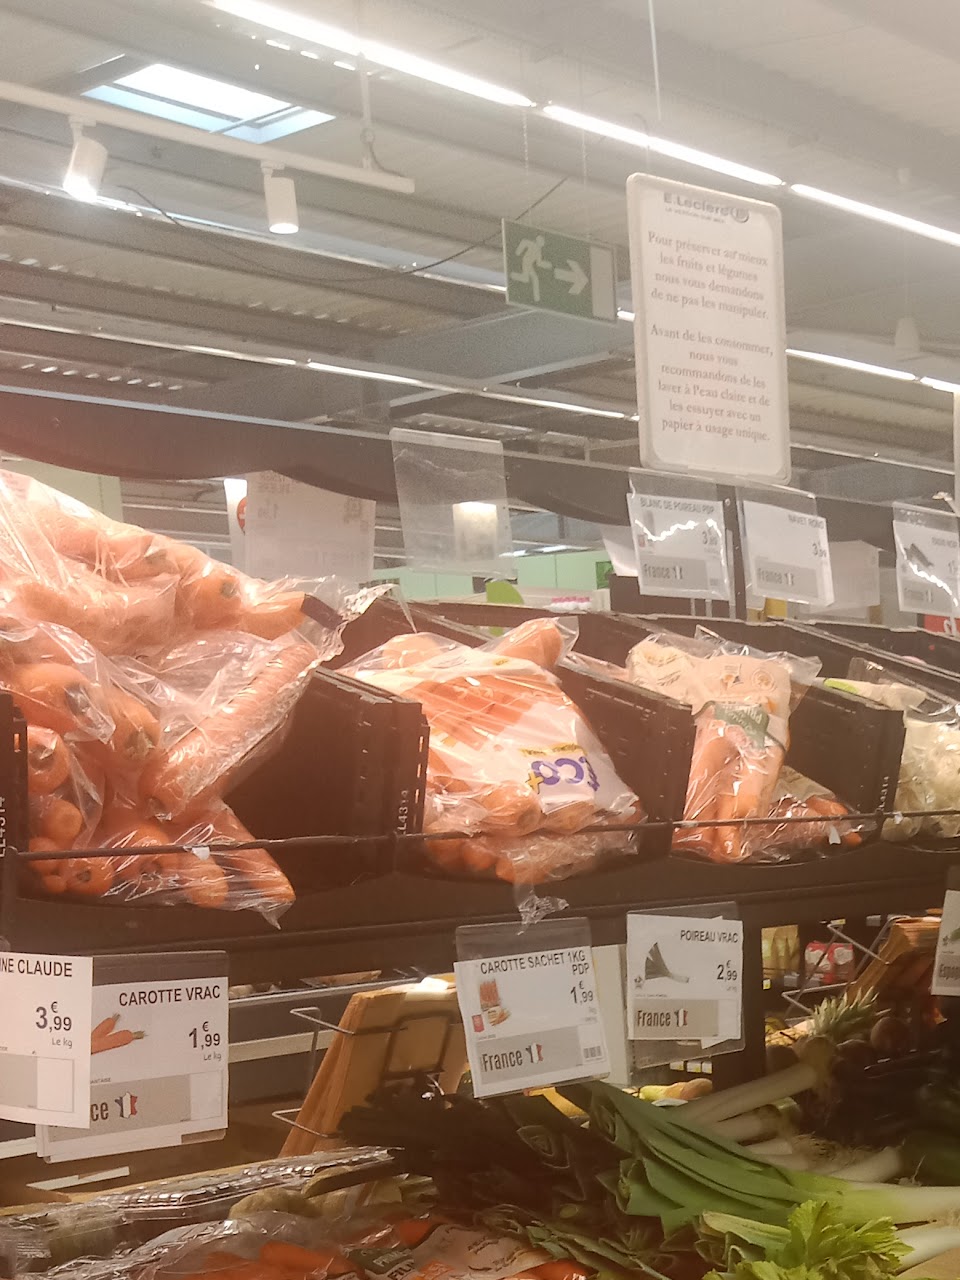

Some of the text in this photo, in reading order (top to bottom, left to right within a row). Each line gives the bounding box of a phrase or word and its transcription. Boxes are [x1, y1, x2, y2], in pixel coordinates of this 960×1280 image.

[648, 231, 672, 246] Pour
[738, 251, 768, 267] mieux
[660, 252, 758, 282] les fruits et légumes
[655, 273, 764, 301] nous vous demandons
[651, 288, 664, 299] de
[666, 293, 678, 303] ne
[682, 296, 699, 309] pas
[702, 296, 716, 310] les
[650, 324, 679, 339] Avant
[683, 329, 695, 342] de
[698, 332, 712, 344] les
[689, 351, 738, 366] nous vous
[661, 364, 766, 389] recommandons de les
[658, 380, 681, 393] laver
[684, 386, 691, 395] à
[720, 388, 746, 403] claire
[748, 395, 756, 404] et
[759, 395, 771, 407] de
[669, 399, 761, 422] les essuyer avec un
[662, 418, 693, 433] papier
[705, 424, 733, 438] usage
[680, 930, 739, 943] POIREAU VRAC
[17, 959, 73, 978] CLAUDE
[480, 950, 586, 975] CAROTTE SACHET 1KG
[572, 963, 590, 976] PDP
[119, 985, 221, 1008] CAROTTE VRAC
[637, 1009, 671, 1028] France
[52, 1038, 73, 1049] Le kg
[213, 1052, 222, 1061] kg
[482, 1049, 523, 1073] France
